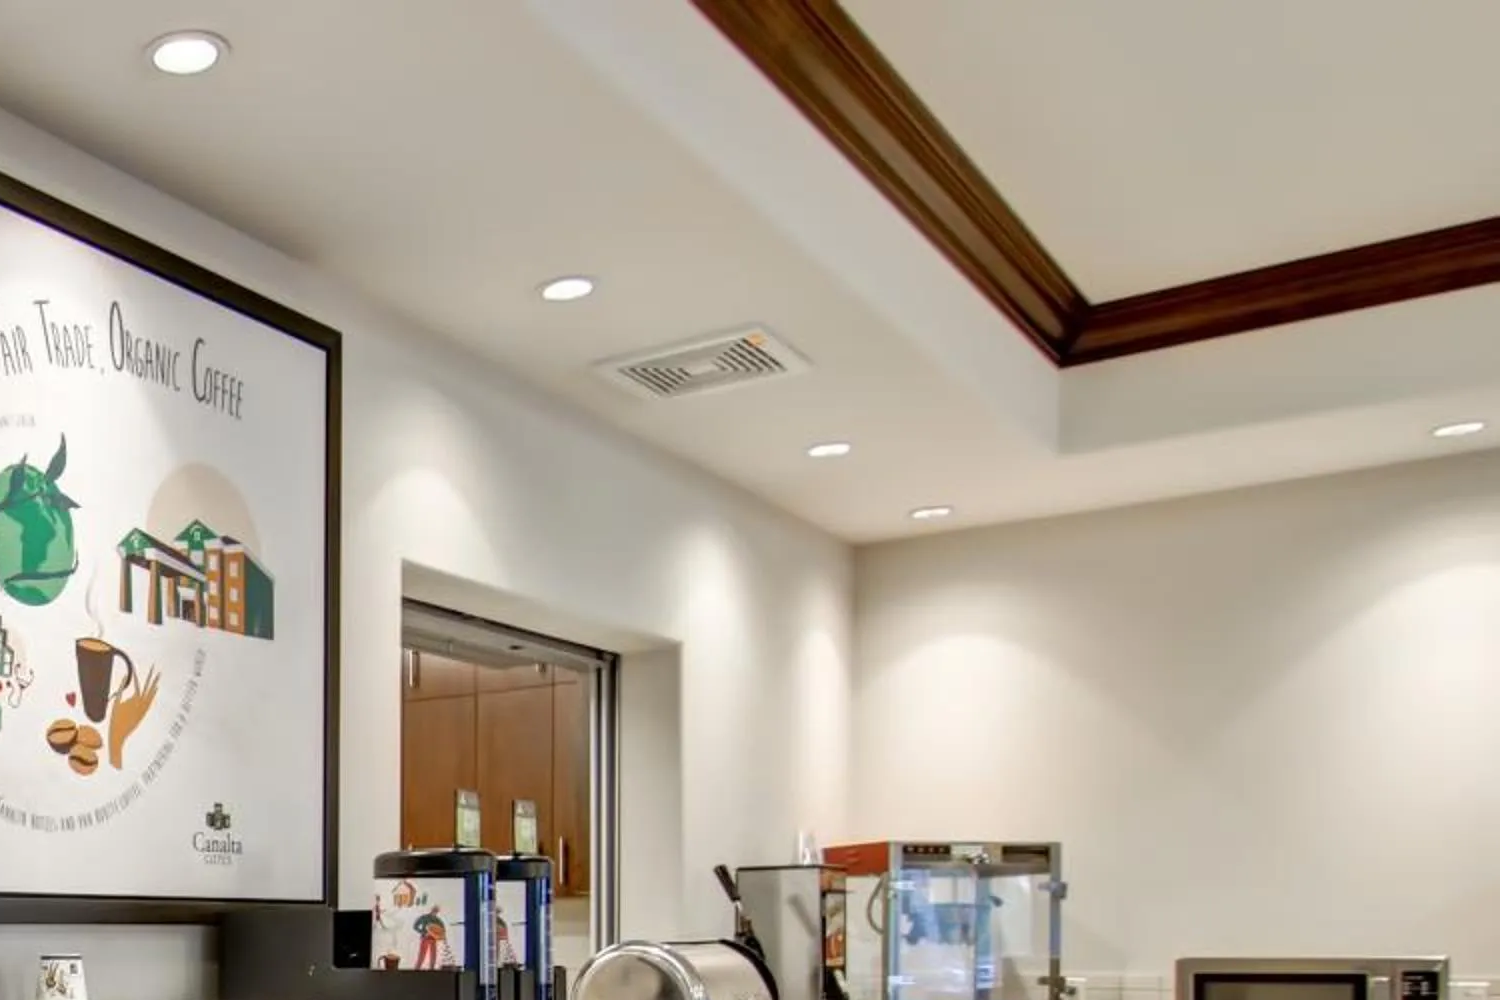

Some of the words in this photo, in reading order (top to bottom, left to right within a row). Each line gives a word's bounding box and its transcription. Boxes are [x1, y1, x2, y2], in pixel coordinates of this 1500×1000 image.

[108, 300, 182, 392] ORGANIC
[191, 337, 245, 421] COFFEE
[192, 831, 243, 855] Canalta
